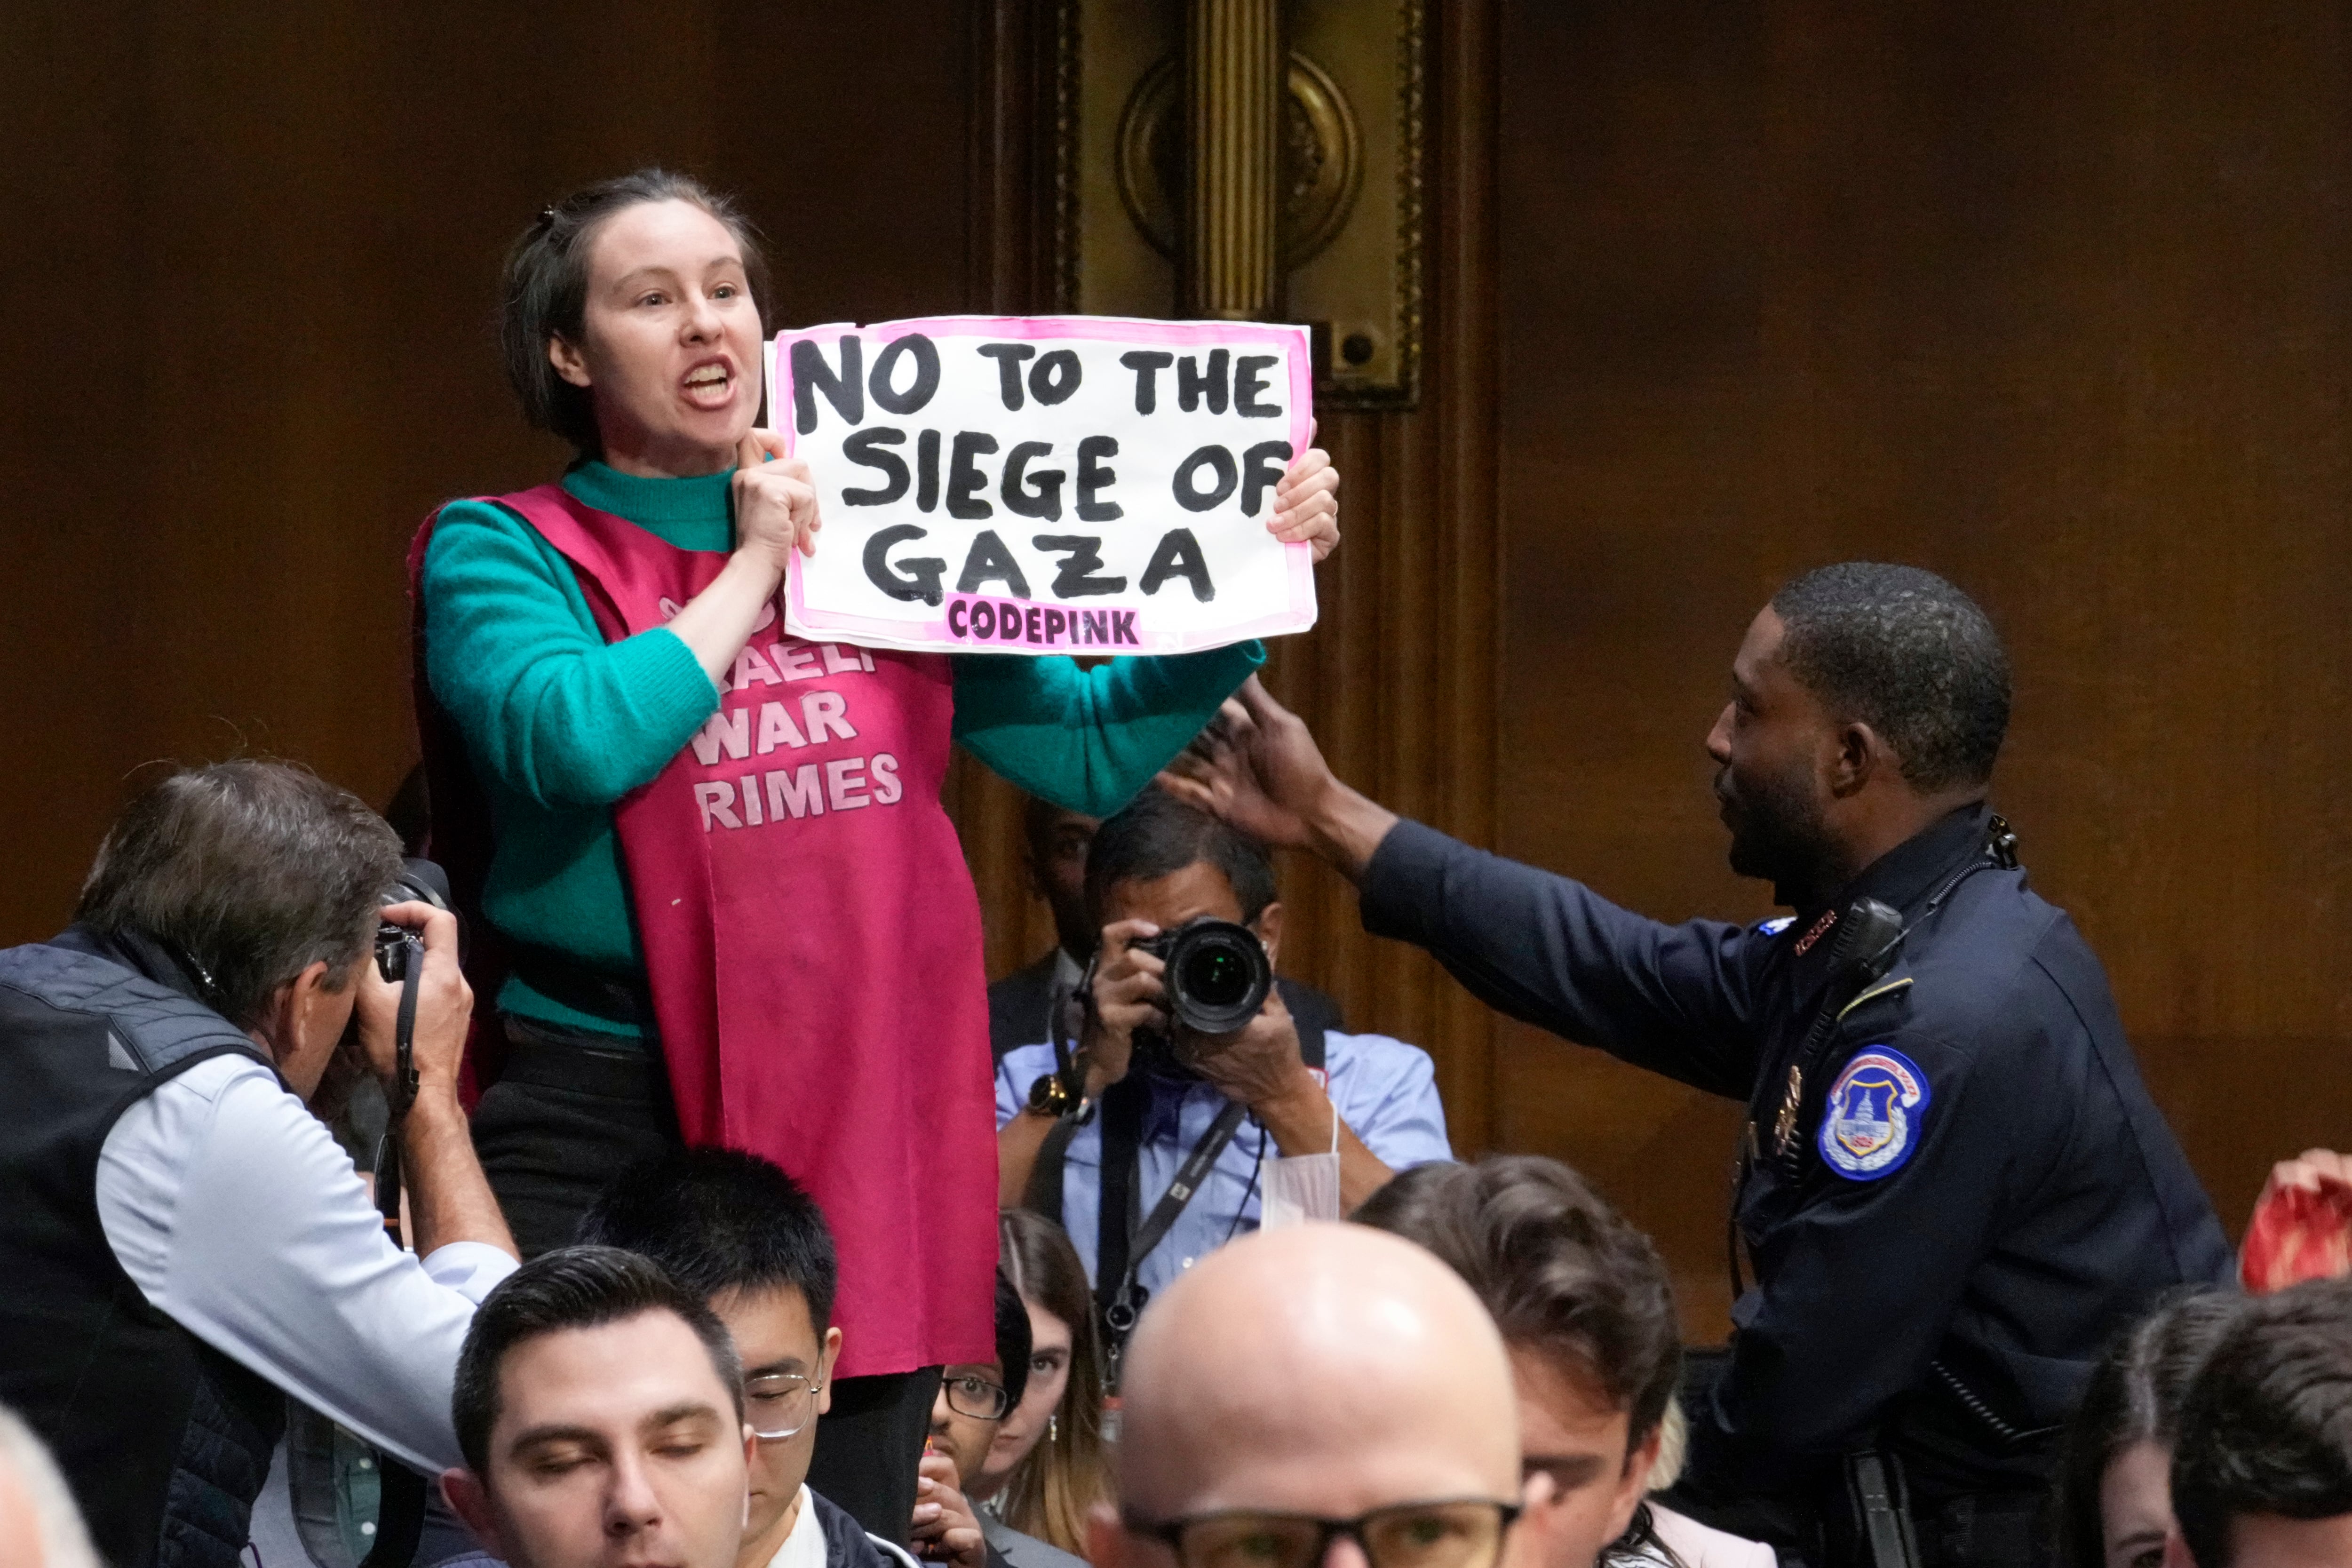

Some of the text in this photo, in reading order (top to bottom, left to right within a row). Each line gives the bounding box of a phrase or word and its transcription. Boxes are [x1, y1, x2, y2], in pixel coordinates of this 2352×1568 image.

[791, 333, 1283, 435] NO TO THE
[842, 426, 1294, 522] SIEGE OF
[863, 524, 1215, 606] GAZA
[948, 600, 1138, 645] CODEPINK
[691, 690, 858, 765] WAR
